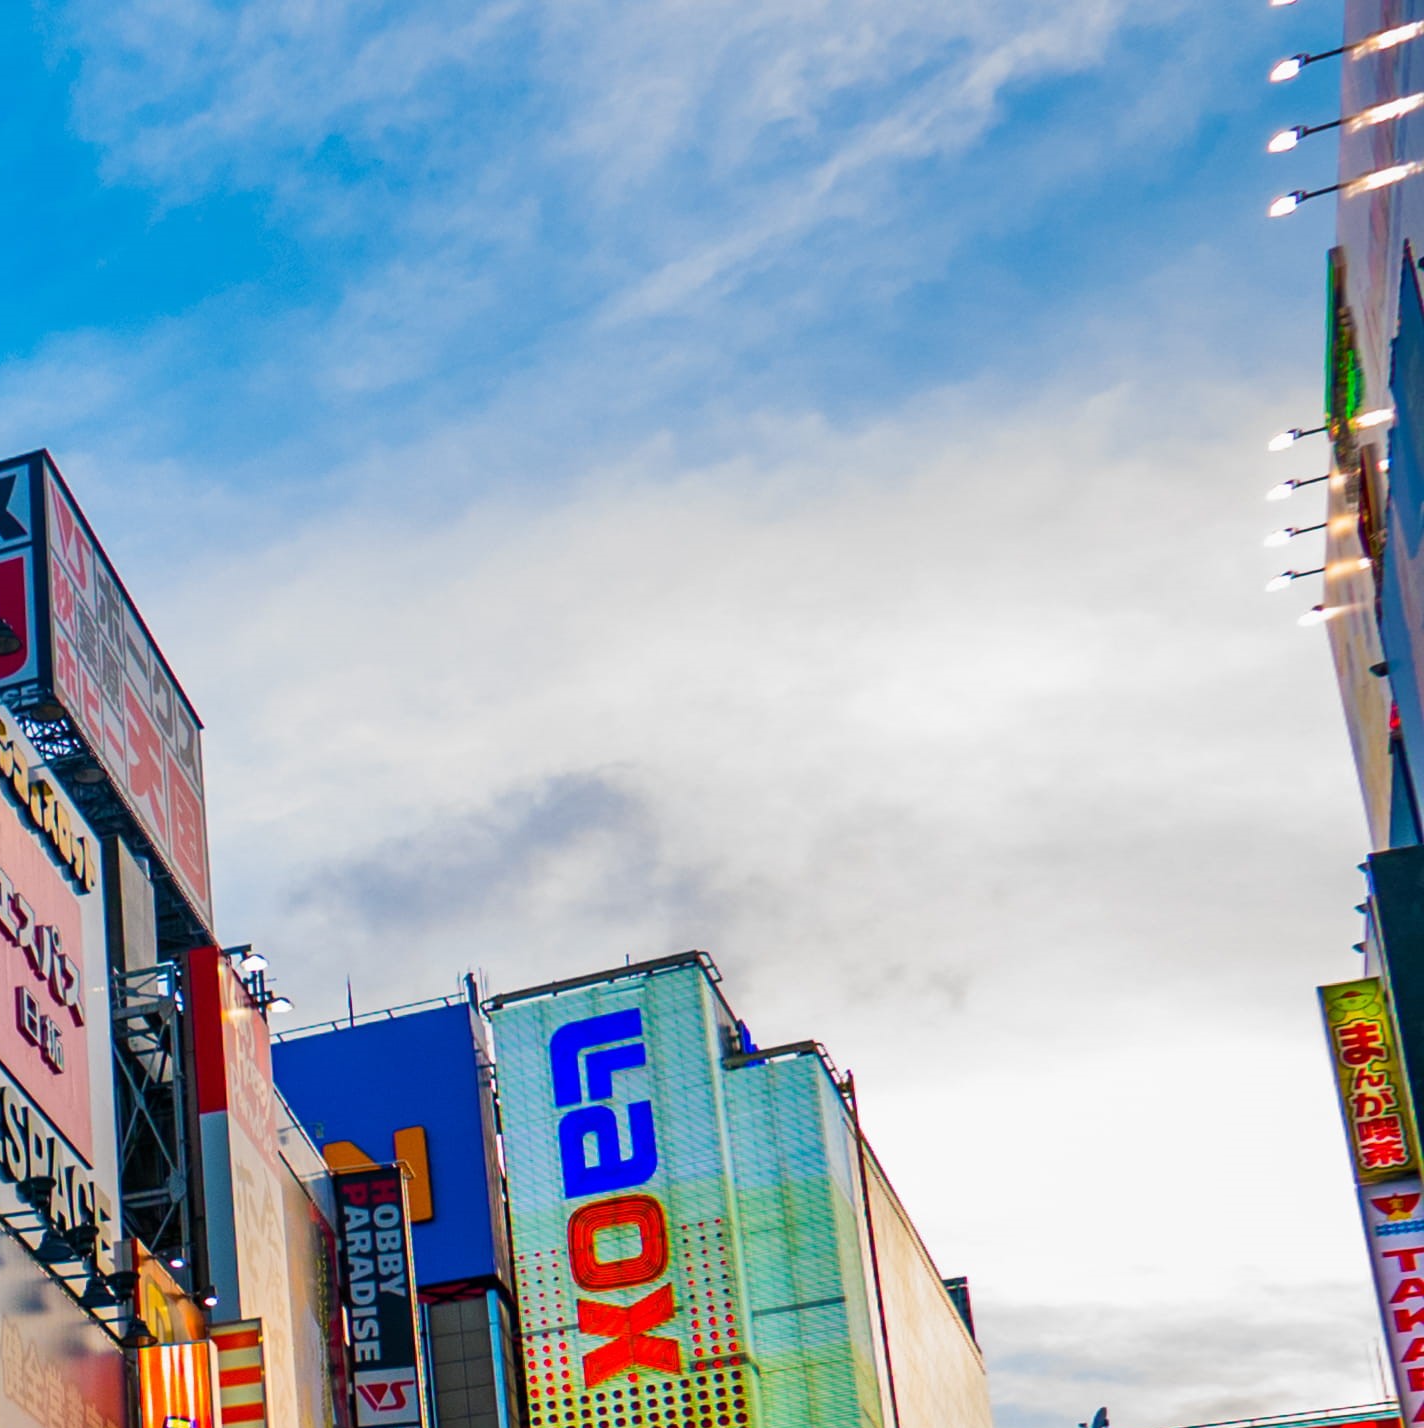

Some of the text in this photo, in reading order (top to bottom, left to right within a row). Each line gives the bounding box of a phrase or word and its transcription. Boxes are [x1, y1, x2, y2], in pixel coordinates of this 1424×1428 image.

[1337, 1018, 1408, 1171] まんが喫茶
[342, 1178, 381, 1364] PARADISE
[371, 1178, 406, 1298] HOBBY
